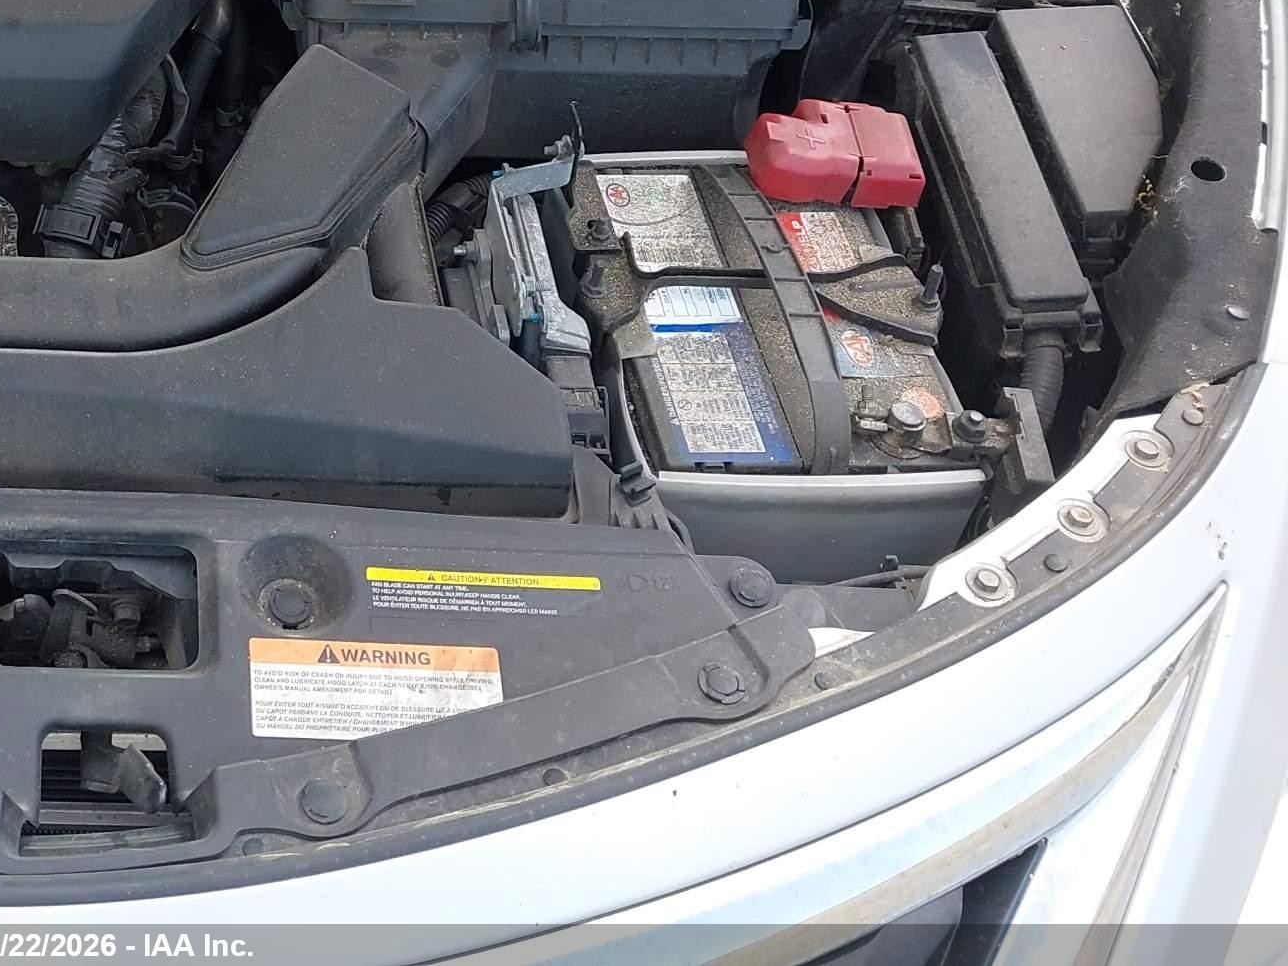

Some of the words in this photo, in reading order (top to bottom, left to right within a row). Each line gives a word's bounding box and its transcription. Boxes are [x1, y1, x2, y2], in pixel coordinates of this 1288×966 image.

[442, 574, 481, 582] CAUTION
[491, 576, 540, 585] ATTENTION
[341, 648, 431, 665] WARNING
